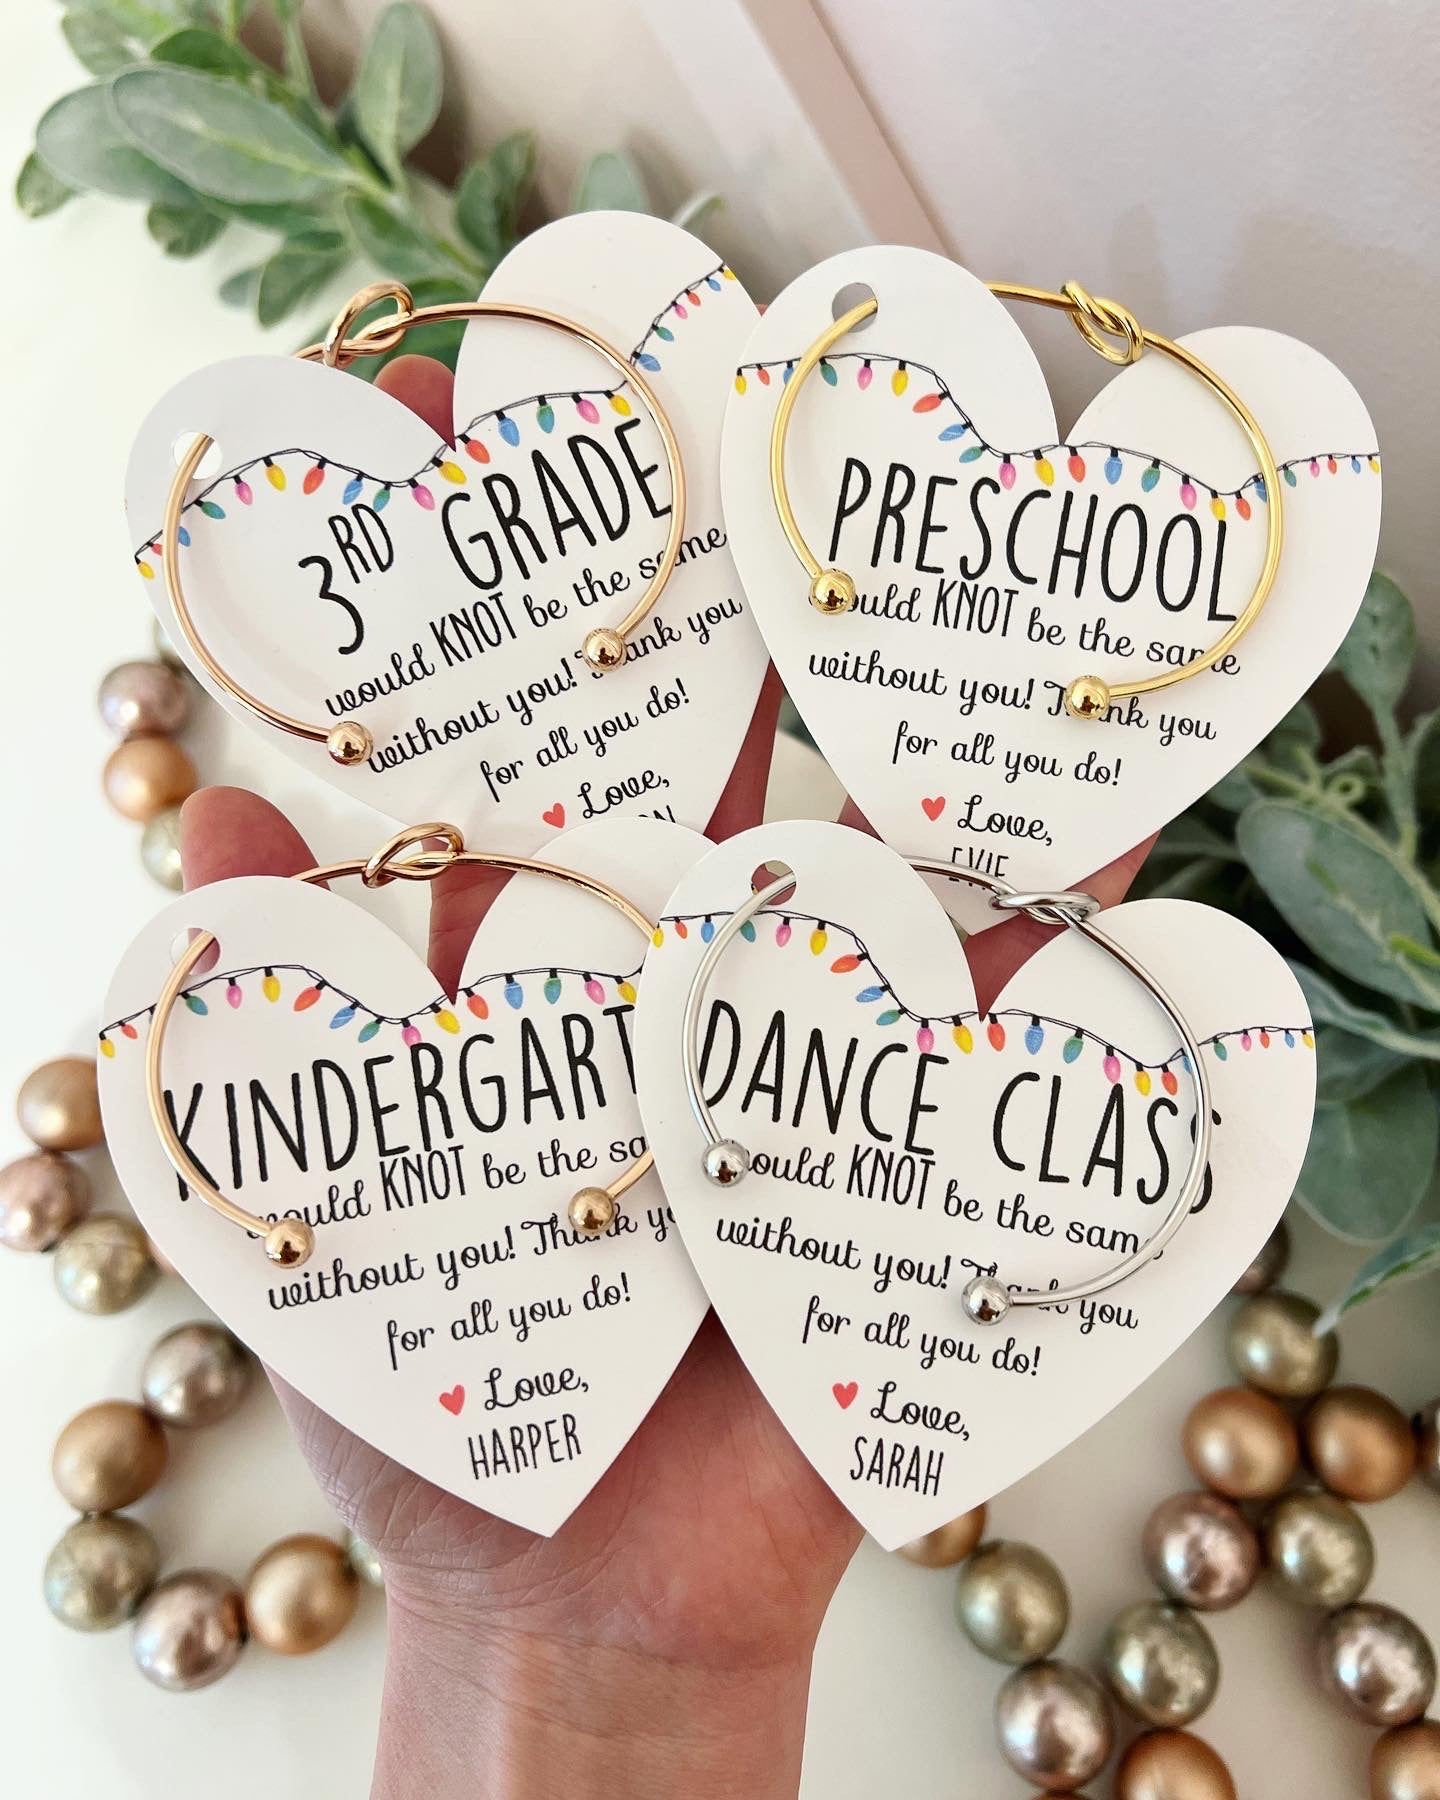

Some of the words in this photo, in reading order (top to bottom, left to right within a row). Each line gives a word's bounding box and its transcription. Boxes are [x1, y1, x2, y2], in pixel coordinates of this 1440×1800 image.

[298, 503, 395, 656] 3RD
[441, 417, 672, 590] GRADE
[829, 457, 1237, 623] PRESCHOOL
[325, 643, 436, 716] would
[429, 592, 517, 667] KNOT
[524, 594, 567, 629] be
[573, 568, 630, 607] the
[808, 583, 921, 622] uld
[932, 578, 1019, 638] KNOT
[1028, 607, 1066, 646] be
[1079, 616, 1135, 658] the
[367, 700, 500, 773] without
[507, 658, 578, 723] you!
[575, 617, 682, 679] ank
[687, 599, 743, 645] you
[808, 650, 948, 698] without
[959, 676, 1035, 716] you!
[1044, 680, 1149, 729] Tnk
[1159, 714, 1217, 746] you
[480, 759, 524, 802] for
[537, 726, 578, 769] all
[584, 713, 639, 758] you
[646, 678, 690, 720] do!
[892, 720, 938, 765] for
[951, 732, 996, 766] all
[1005, 749, 1063, 785] you
[1074, 750, 1123, 787] do!
[577, 770, 670, 819] Love,
[957, 794, 1052, 846] Love,
[163, 1004, 637, 1201] KINDERGART
[699, 999, 950, 1156] DANCE
[381, 1145, 467, 1212] KNOT
[482, 1152, 527, 1190] be
[538, 1138, 598, 1178] the
[609, 1136, 647, 1163] sa
[747, 1147, 835, 1189] ould
[845, 1143, 937, 1212] KNOT
[943, 1179, 984, 1221] be
[997, 1197, 1055, 1238] the
[1066, 1221, 1164, 1260] sam
[268, 1249, 426, 1311] without
[437, 1225, 516, 1292] you!
[520, 1203, 638, 1256] Thk
[715, 1216, 862, 1271] without
[873, 1254, 953, 1293] you!
[1079, 1299, 1139, 1335] you
[387, 1321, 435, 1371] for
[450, 1299, 499, 1343] all
[509, 1299, 572, 1343] you
[582, 1271, 631, 1311] do!
[801, 1295, 851, 1345] for
[864, 1307, 910, 1351] all
[920, 1327, 980, 1370] you
[991, 1338, 1041, 1376] do!
[483, 1366, 590, 1412] Love,
[870, 1380, 971, 1442] Love,
[467, 1413, 582, 1480] HARPER
[849, 1435, 944, 1498] SARAH
